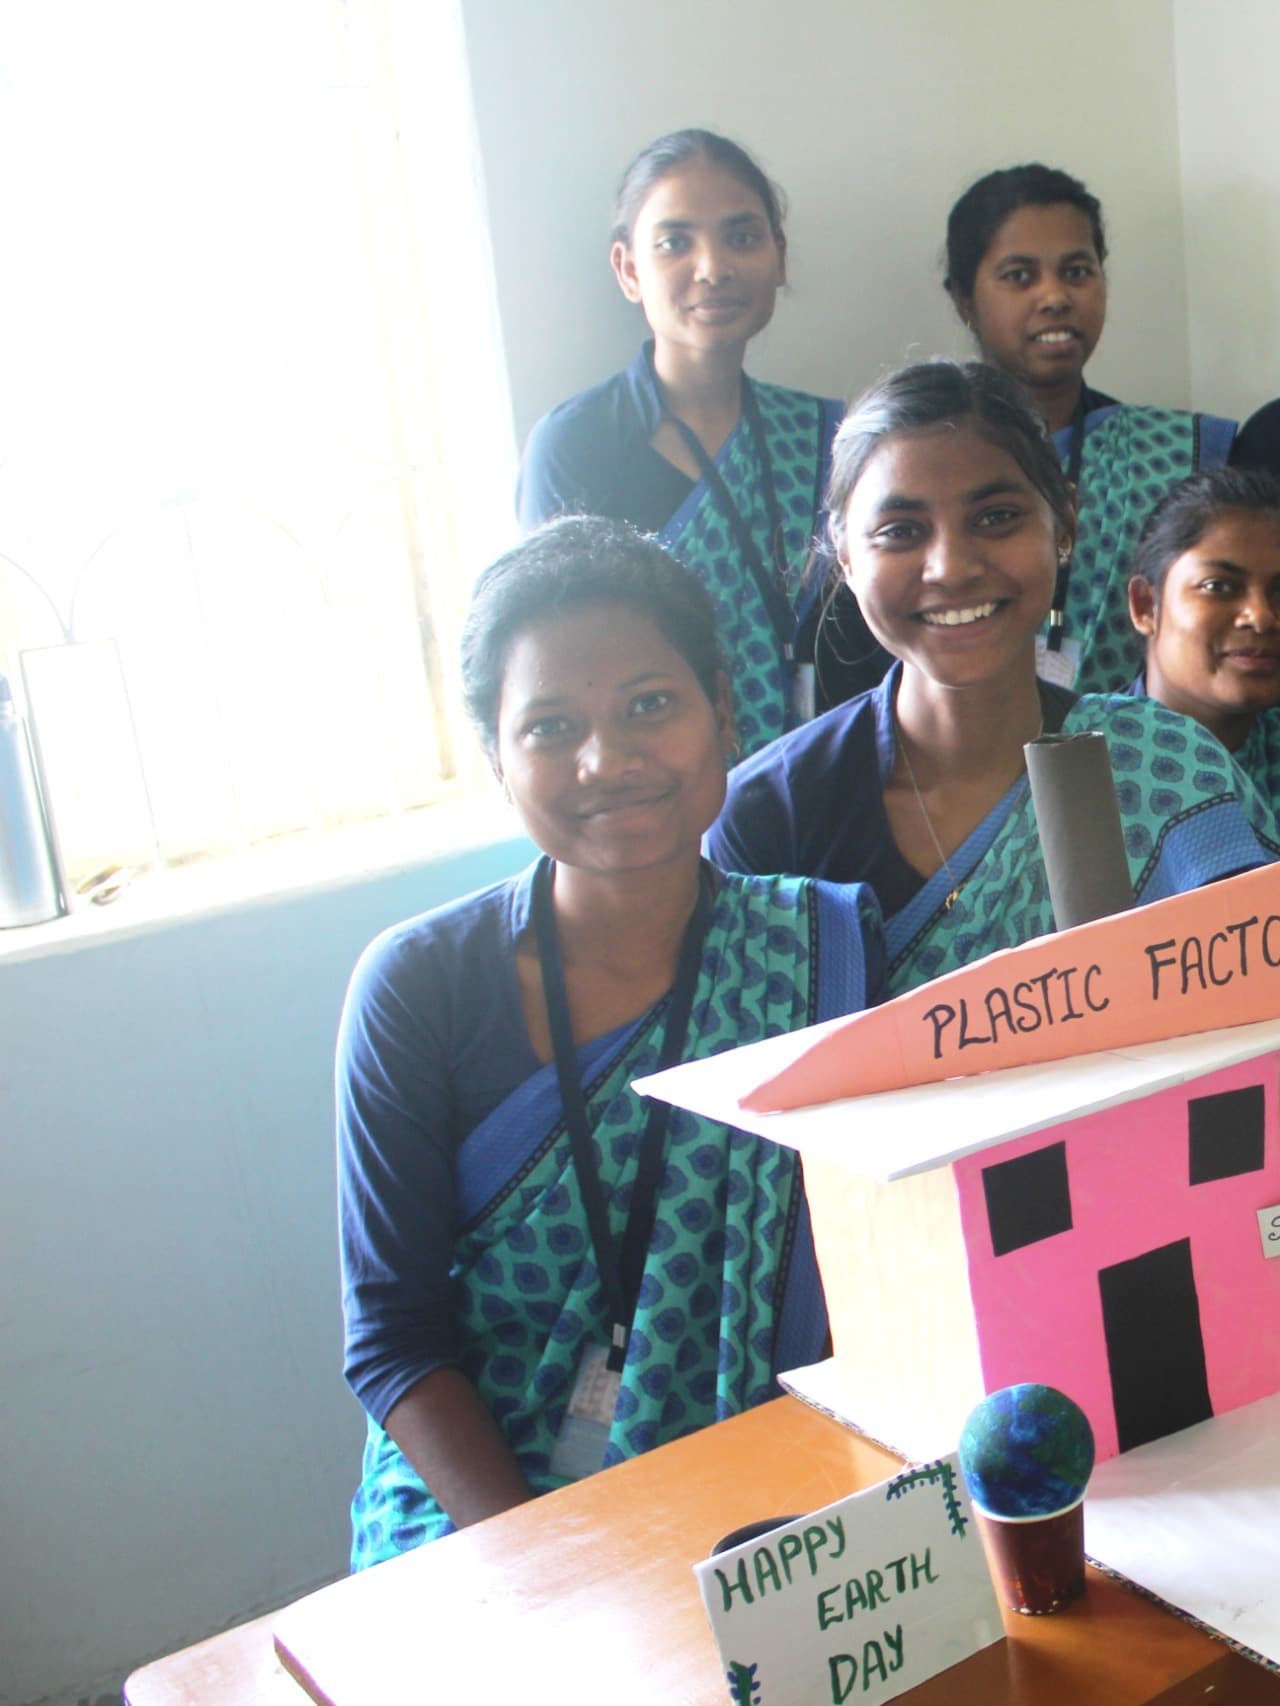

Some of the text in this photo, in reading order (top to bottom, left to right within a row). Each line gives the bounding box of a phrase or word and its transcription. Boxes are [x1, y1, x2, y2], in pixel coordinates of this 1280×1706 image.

[923, 963, 1110, 1060] PLASTIC
[714, 1515, 846, 1612] HAPPY
[816, 1547, 939, 1631] EARTH
[828, 1624, 903, 1705] DAY
